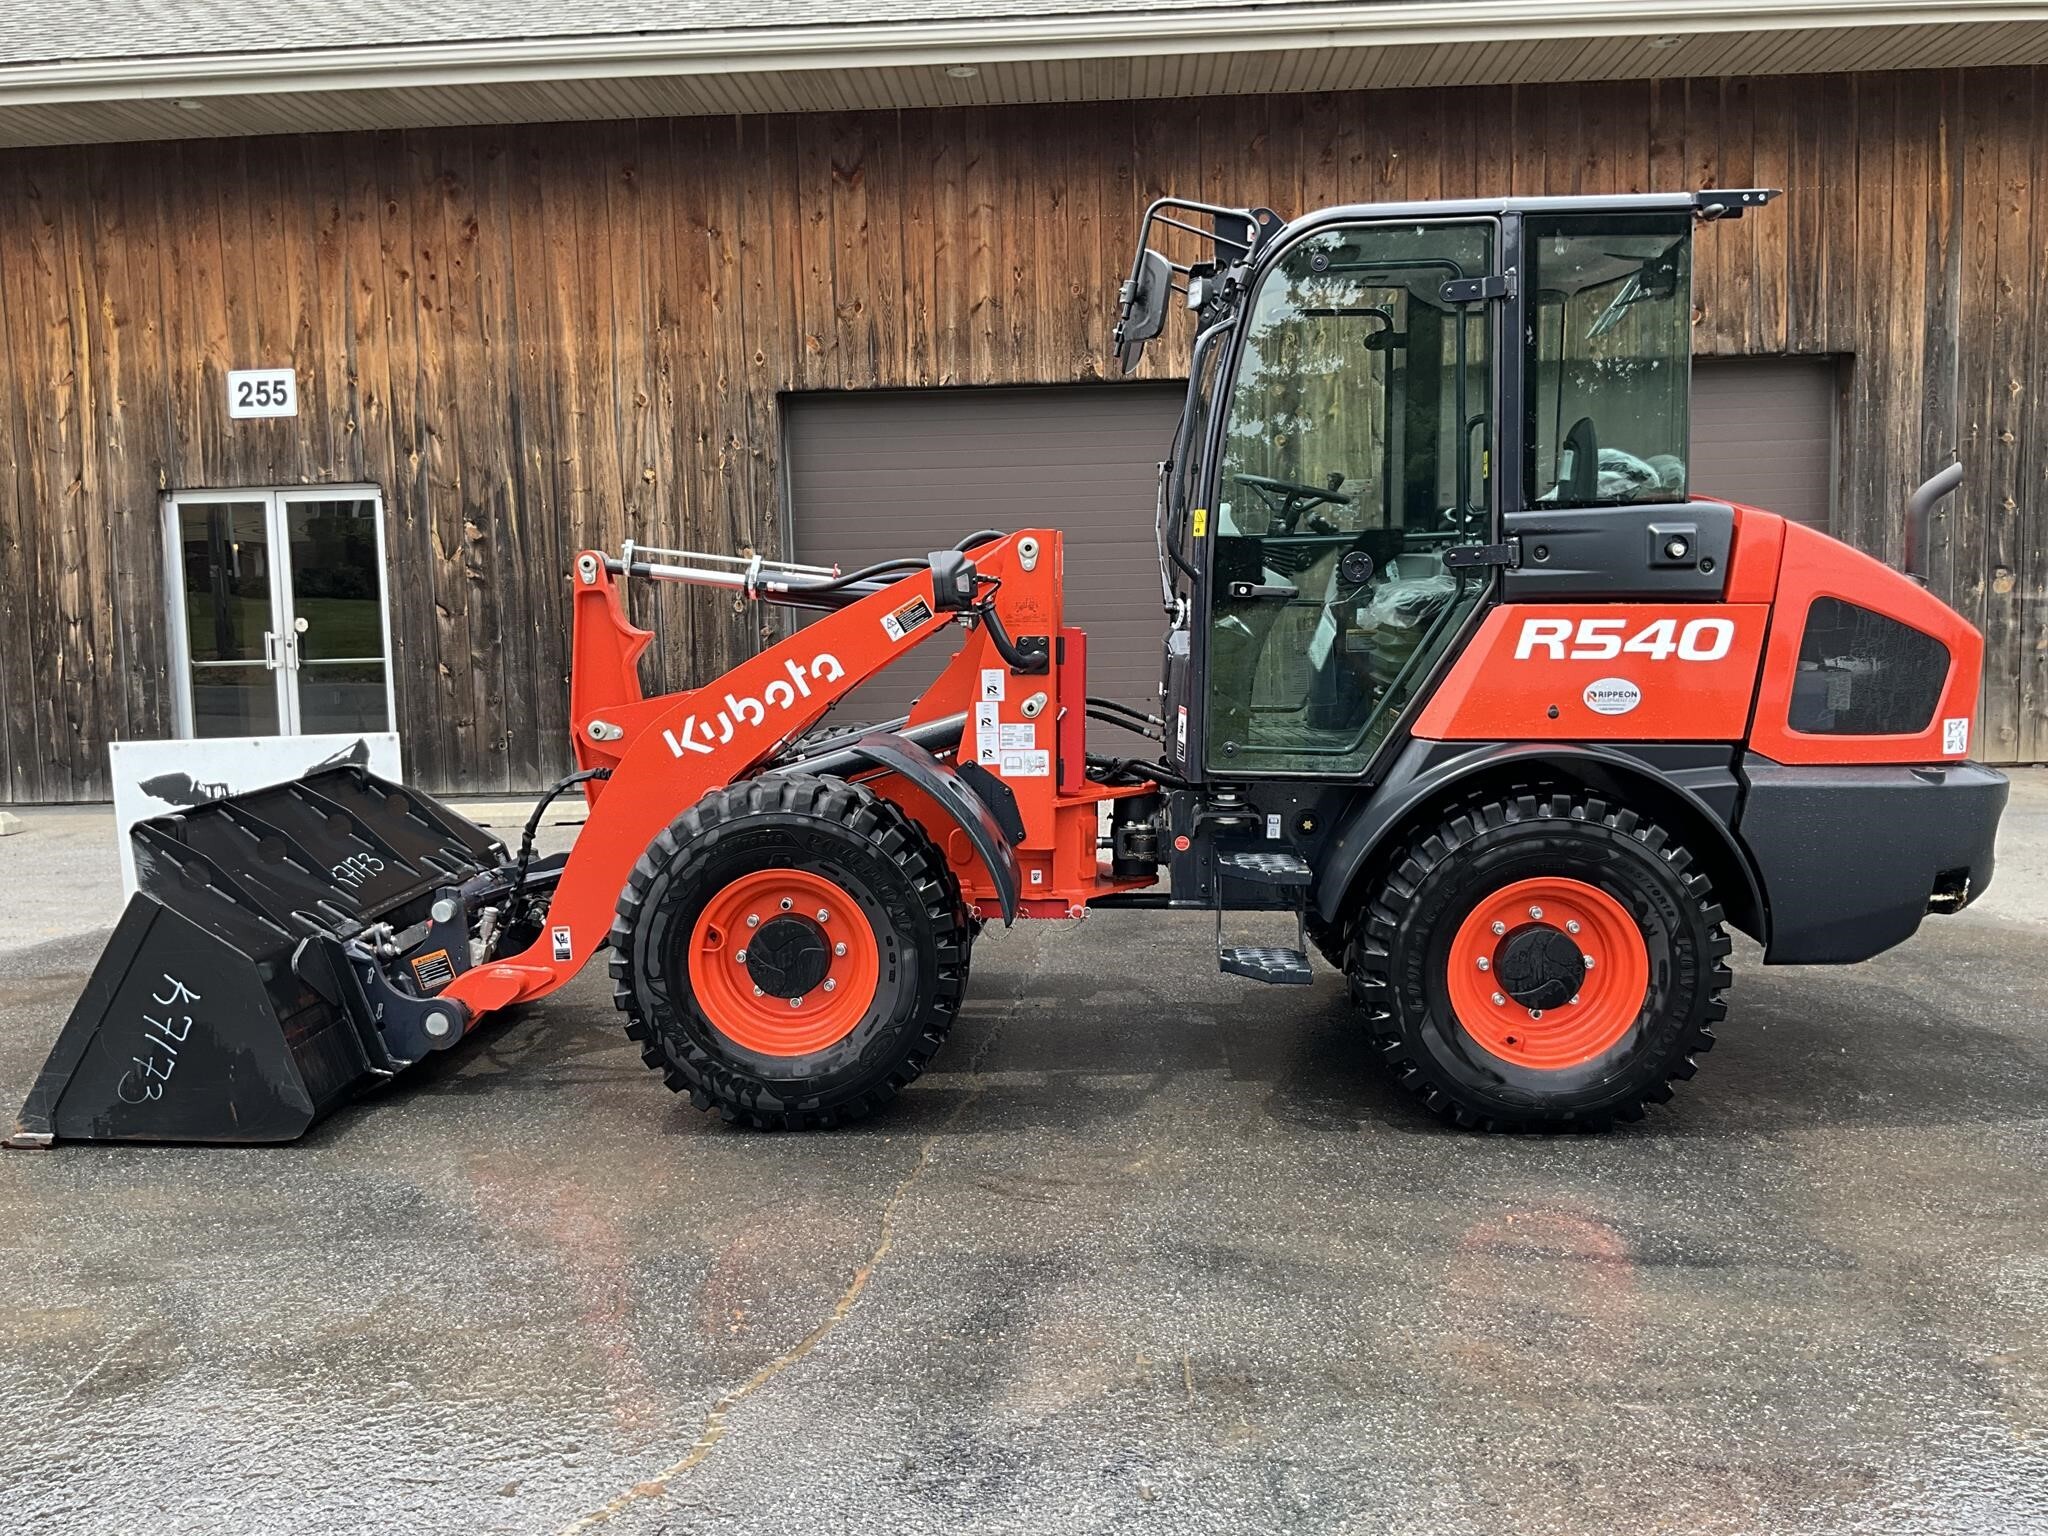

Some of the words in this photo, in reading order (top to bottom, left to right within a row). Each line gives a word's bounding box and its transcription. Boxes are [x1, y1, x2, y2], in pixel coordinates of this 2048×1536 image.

[238, 380, 288, 408] 255
[1513, 618, 1736, 662] R540
[662, 653, 846, 759] Kubota
[1598, 690, 1638, 698] RIPPEON
[117, 974, 201, 1104] K7173
